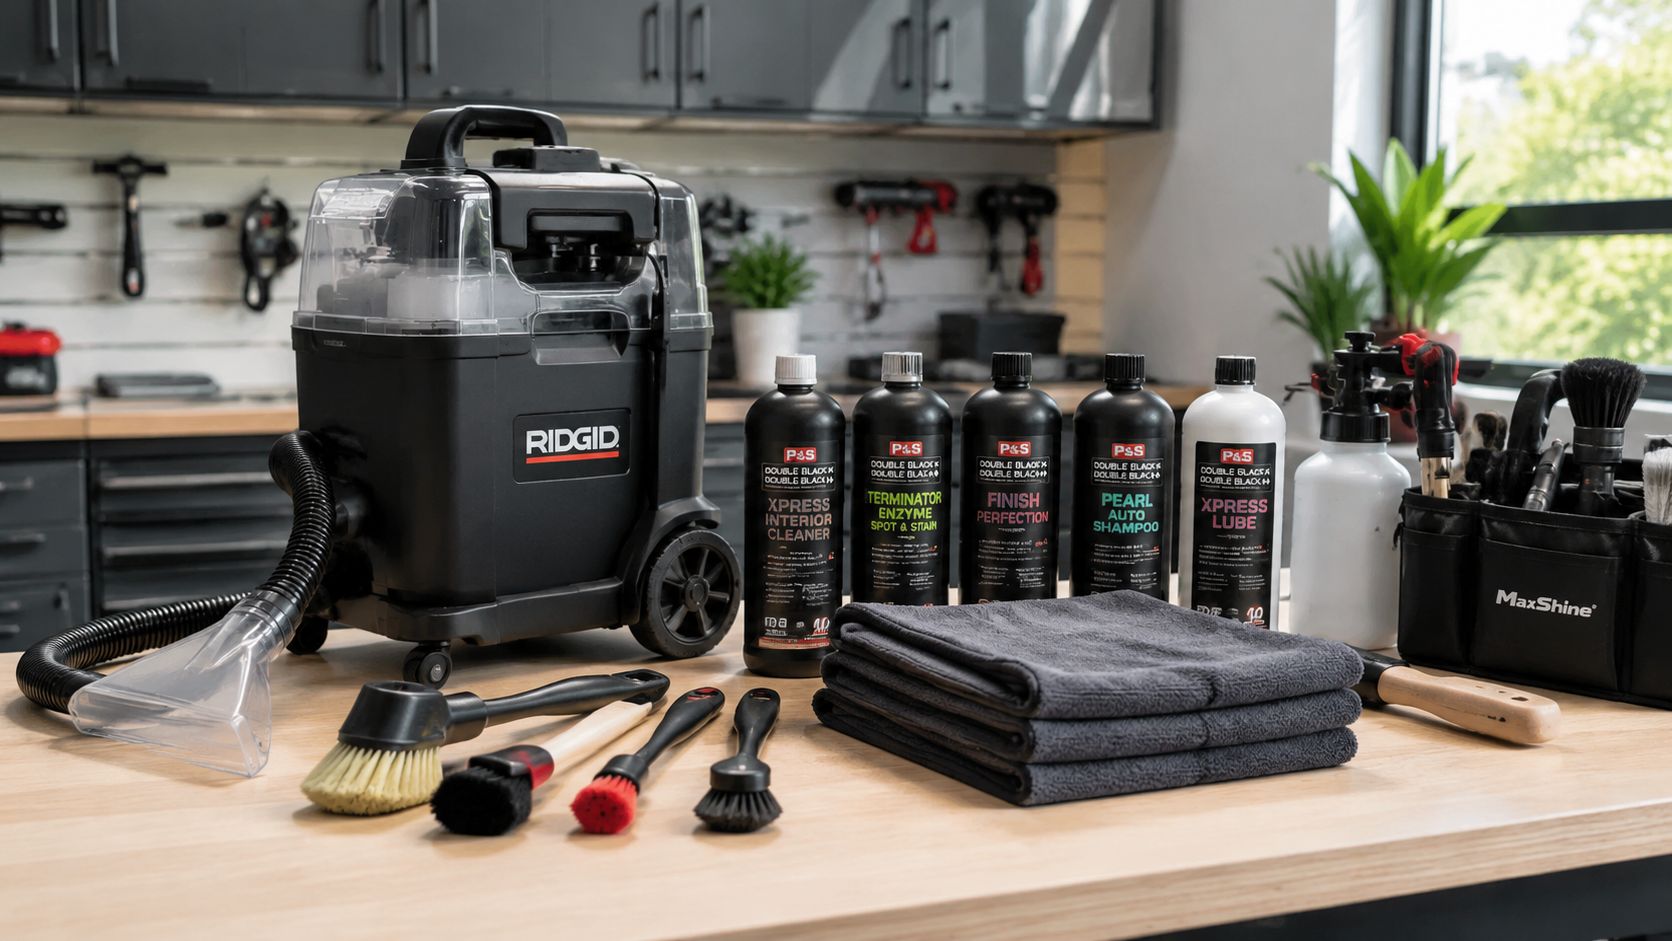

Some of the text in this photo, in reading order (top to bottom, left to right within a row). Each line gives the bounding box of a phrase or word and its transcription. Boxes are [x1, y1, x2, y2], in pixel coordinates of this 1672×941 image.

[892, 443, 921, 455] P&S
[1000, 443, 1029, 455] P&S
[1222, 450, 1252, 462] P&S
[764, 467, 799, 475] DOUBLE
[871, 460, 905, 469] DOUBLE
[1093, 461, 1128, 470] DOUBLE
[764, 476, 799, 485] DOUBLE
[768, 497, 831, 513] XPRESS
[867, 491, 942, 506] TERMINATOR
[987, 491, 1040, 509] FINISH
[1101, 492, 1153, 508] PEARL
[1201, 497, 1268, 514] XPRESS
[765, 513, 832, 527] INTERIOR
[879, 507, 933, 520] ENZYME
[977, 510, 1049, 524] PERFECTION
[1108, 509, 1146, 521] AUTO
[871, 521, 897, 532] SPOT
[1093, 521, 1159, 534] SHAMPOO
[1212, 515, 1257, 530] LUBE
[767, 528, 831, 541] CLEANER
